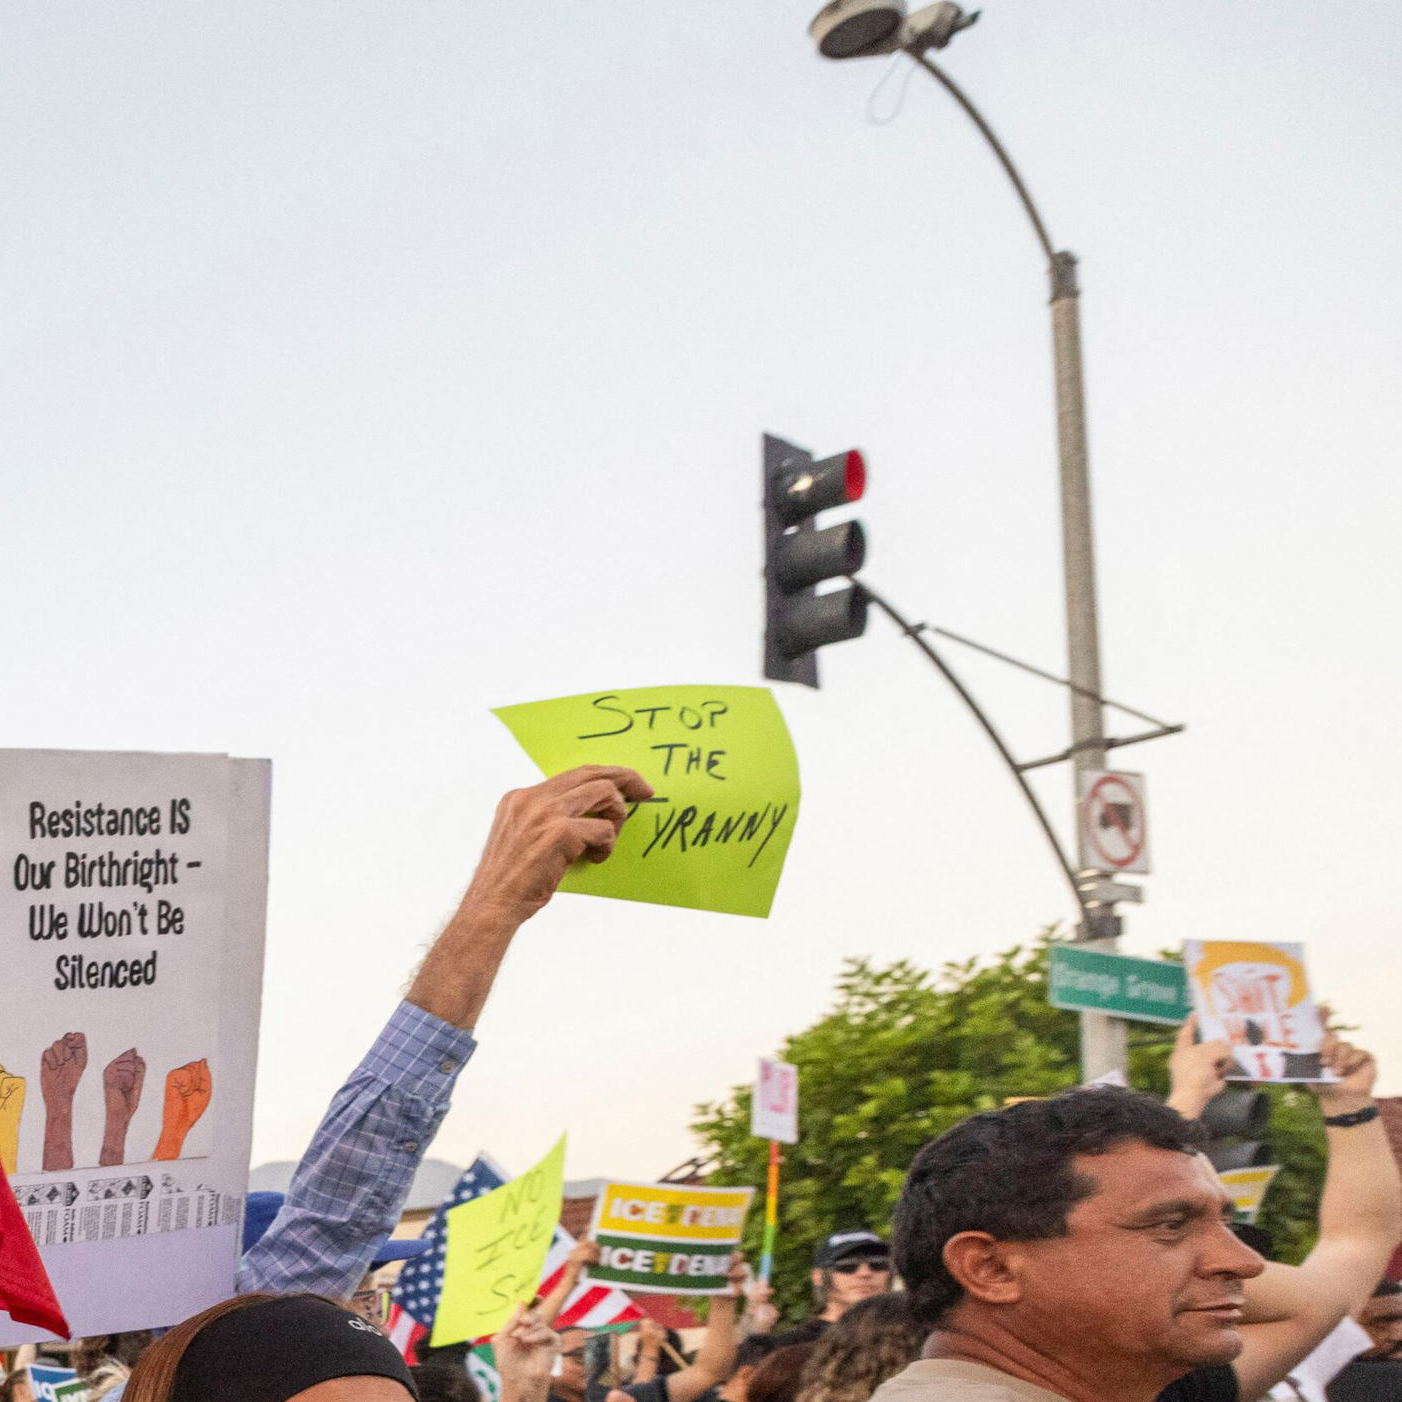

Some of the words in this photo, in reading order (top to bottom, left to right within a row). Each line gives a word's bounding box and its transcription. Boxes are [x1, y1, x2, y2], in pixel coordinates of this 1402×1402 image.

[578, 696, 728, 739] STOP
[650, 743, 727, 780] THE
[29, 800, 160, 839] Resistance
[170, 798, 191, 834] IS
[14, 853, 56, 891] Our
[64, 849, 178, 893] Birthright
[29, 903, 68, 940] We
[78, 901, 148, 938] Won't
[157, 899, 184, 935] Be
[54, 950, 157, 990] Silenced
[609, 1197, 665, 1223] ICE
